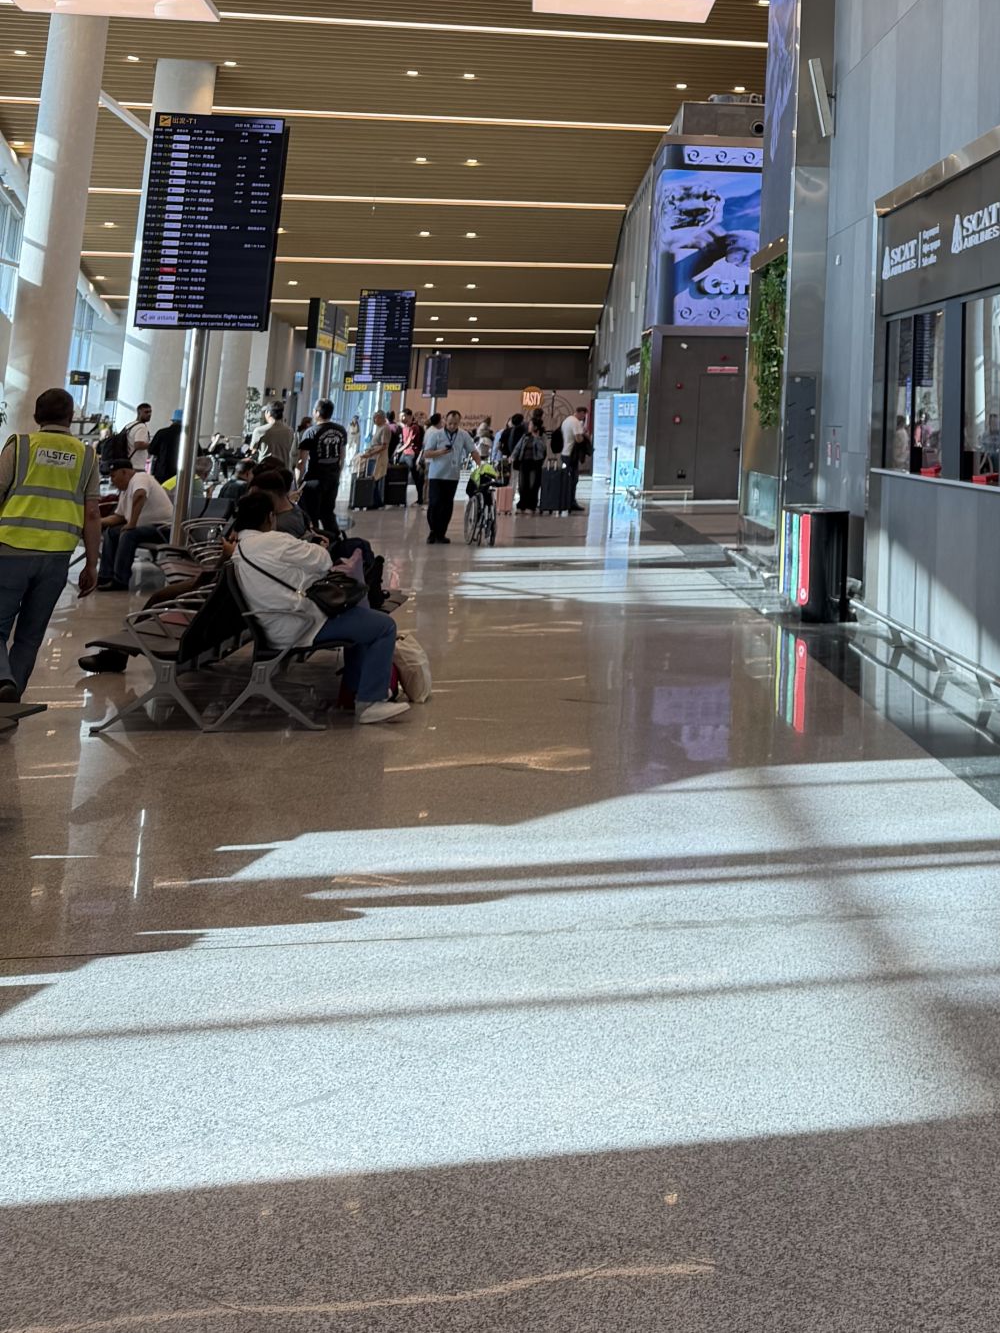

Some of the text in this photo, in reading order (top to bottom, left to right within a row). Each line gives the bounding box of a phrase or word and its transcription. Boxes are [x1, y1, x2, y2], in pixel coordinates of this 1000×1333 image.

[962, 202, 1000, 237] SCAT
[962, 225, 1000, 249] AIRLINES
[890, 239, 917, 266] SCAT
[522, 391, 543, 406] TASTY
[38, 449, 76, 462] ALSTEF
